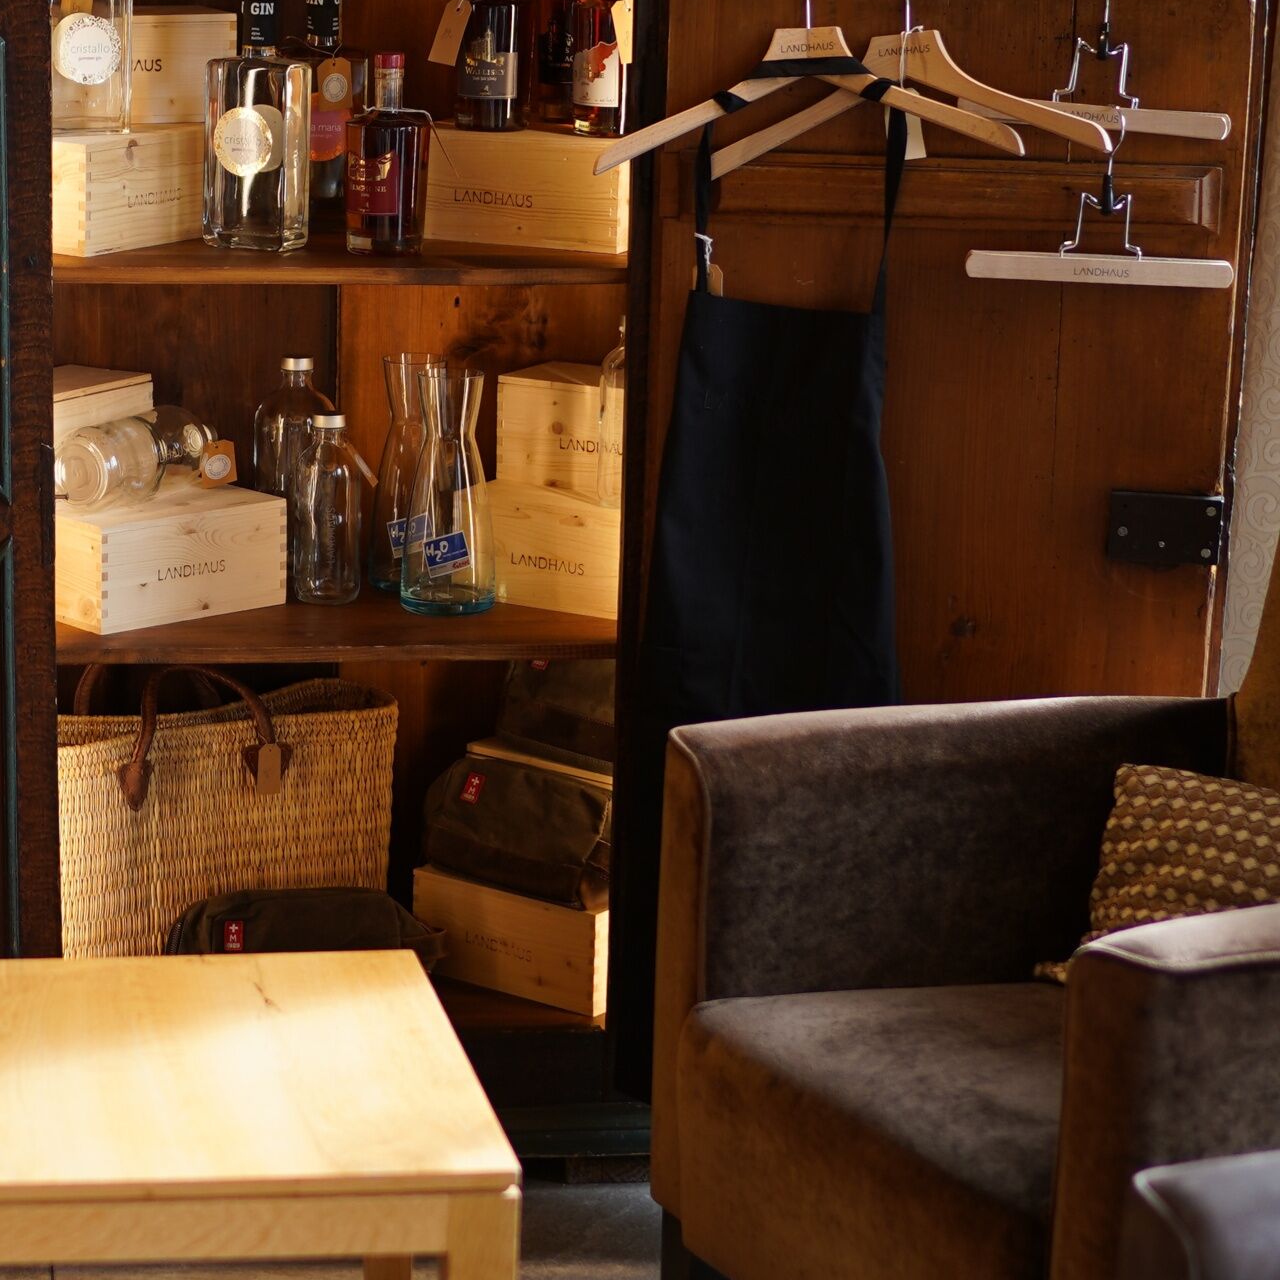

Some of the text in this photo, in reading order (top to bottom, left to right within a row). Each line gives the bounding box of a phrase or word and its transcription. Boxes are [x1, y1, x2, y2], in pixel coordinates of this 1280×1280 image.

[250, 2, 274, 15] GIN
[70, 42, 111, 55] cristallo
[780, 41, 834, 54] LANDHAUS
[1065, 110, 1119, 124] ANDHAUS
[224, 133, 261, 146] cristo
[453, 189, 533, 208] LANDHAUS
[1073, 267, 1130, 279] LANDHAUS
[559, 437, 624, 456] LANDHAU
[158, 559, 226, 582] LANDHAUS
[511, 552, 585, 576] LANDHAUS
